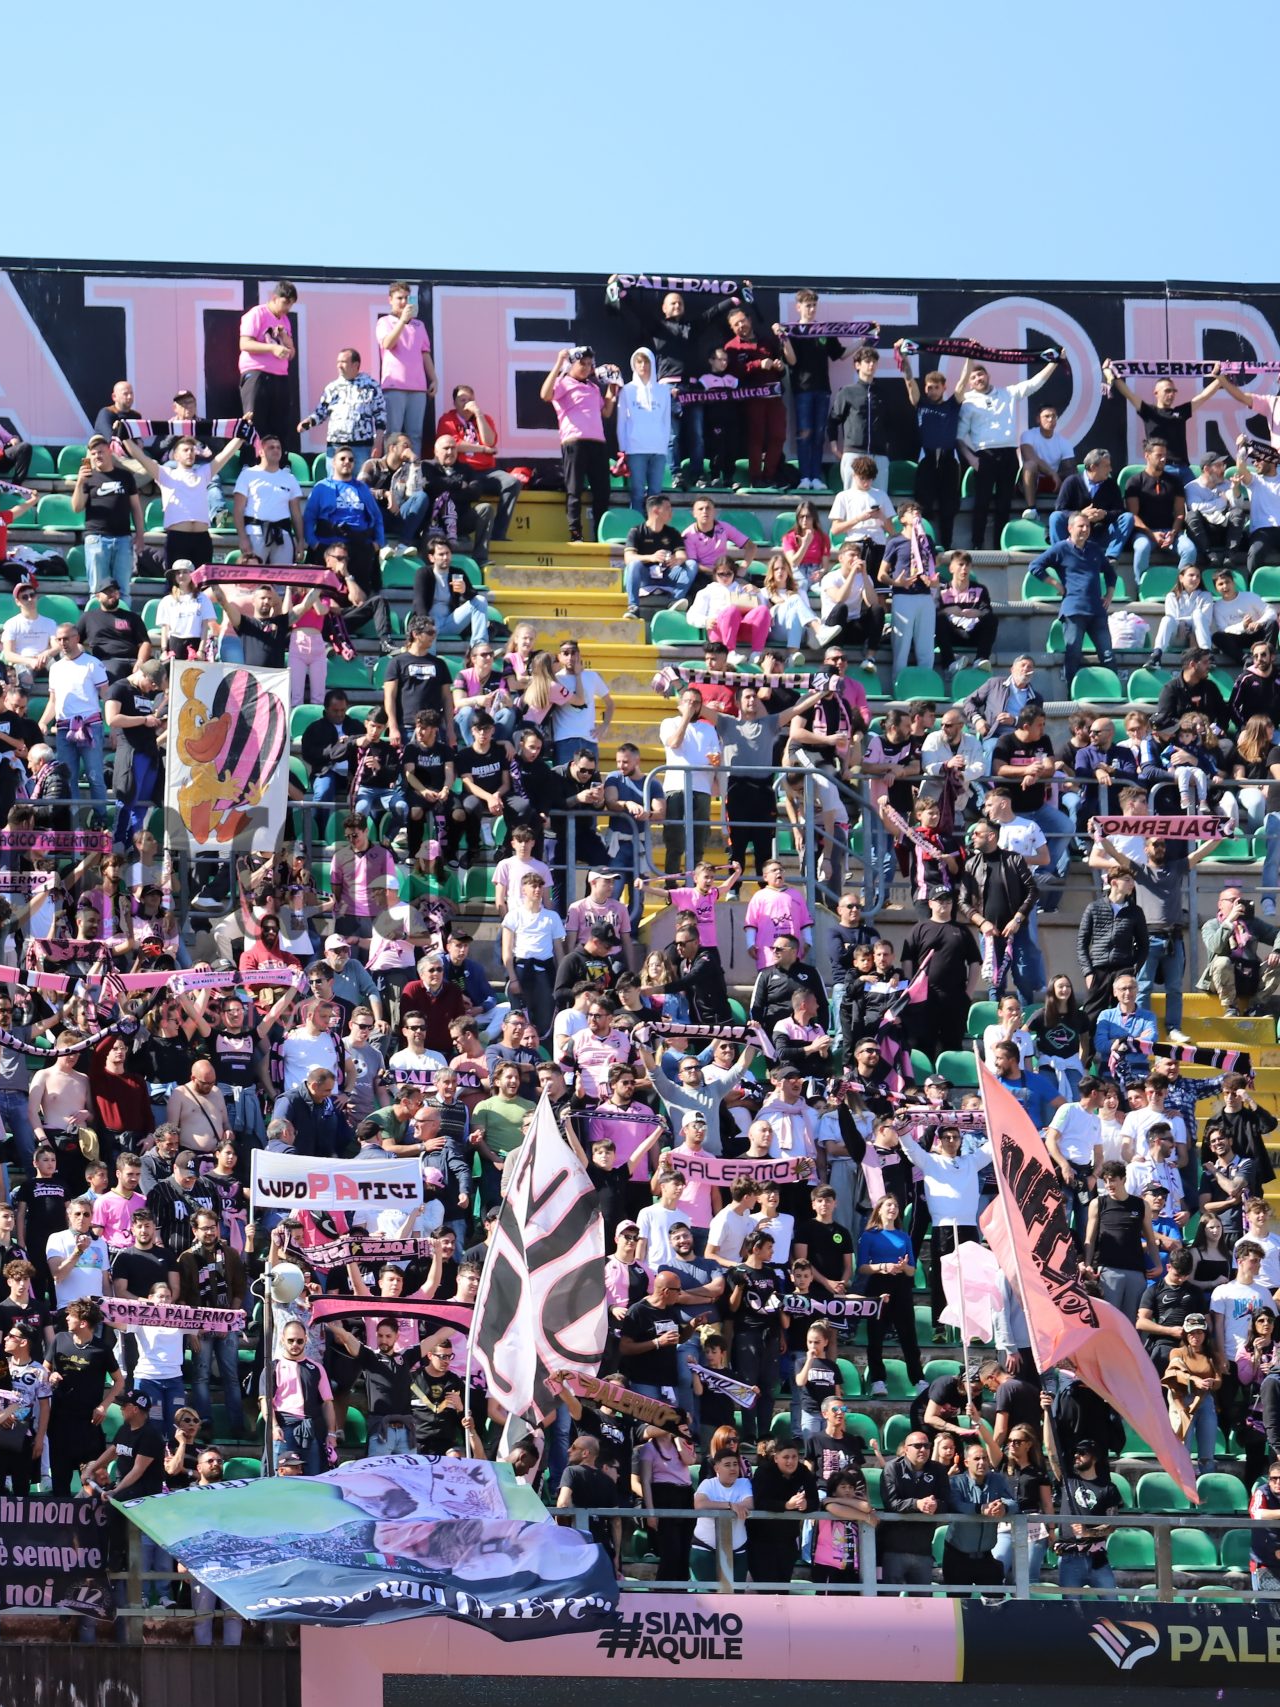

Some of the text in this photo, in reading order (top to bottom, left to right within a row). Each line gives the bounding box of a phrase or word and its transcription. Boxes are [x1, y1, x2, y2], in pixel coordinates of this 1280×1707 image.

[618, 275, 738, 295] PALERMO
[808, 323, 870, 335] PALERMO
[1113, 362, 1219, 375] PALERMO
[732, 385, 771, 399] ultras
[211, 568, 320, 582] Forza Palermo
[41, 834, 98, 848] PALERMO
[395, 1070, 481, 1088] PALMO
[673, 1157, 791, 1182] PALERMO
[257, 1173, 419, 1202] LUDOPATICI
[109, 1304, 235, 1323] FORZA PALERMO
[810, 1298, 882, 1317] NORD
[582, 1381, 673, 1428] PALERMO
[28, 1500, 76, 1525] non
[13, 1542, 103, 1573] sempre
[5, 1578, 55, 1608] noi
[76, 1584, 102, 1605] 12
[637, 1636, 744, 1663] AQUILE
